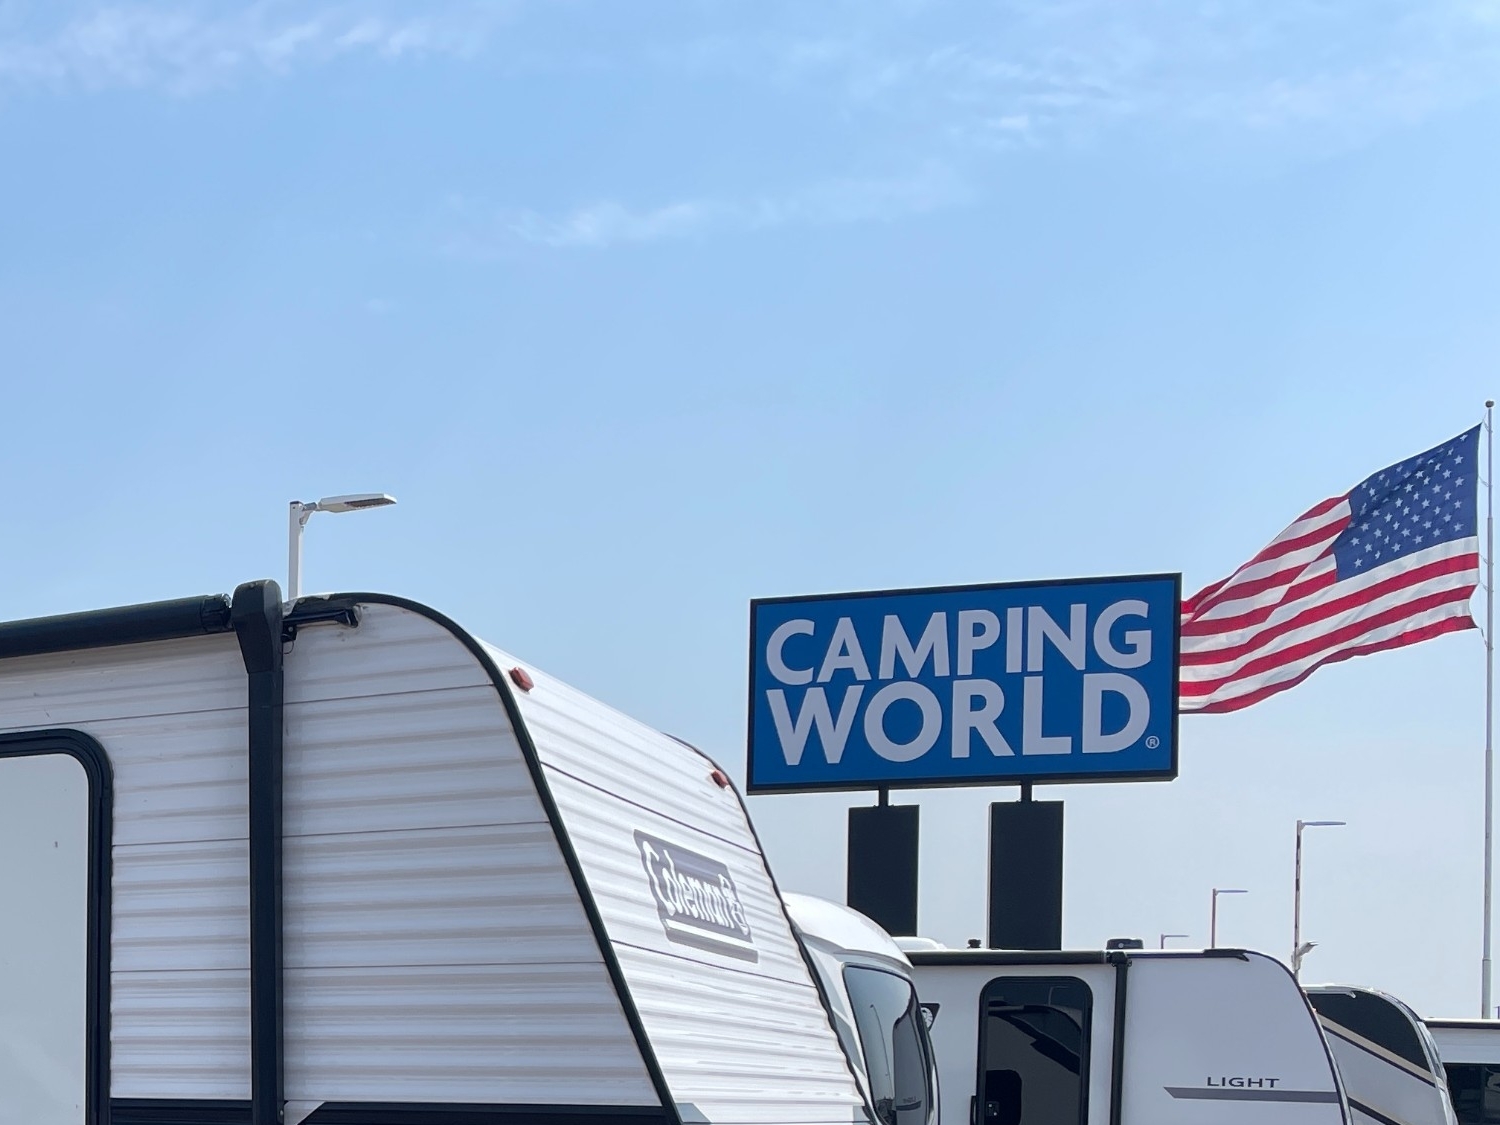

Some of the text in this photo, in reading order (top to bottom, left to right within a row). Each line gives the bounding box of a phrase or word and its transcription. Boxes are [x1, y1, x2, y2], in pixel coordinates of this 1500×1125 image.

[766, 599, 1152, 686] CAMPING
[766, 672, 1151, 766] WORLD
[642, 840, 736, 930] Coleman
[1207, 1076, 1280, 1088] LIGHT
